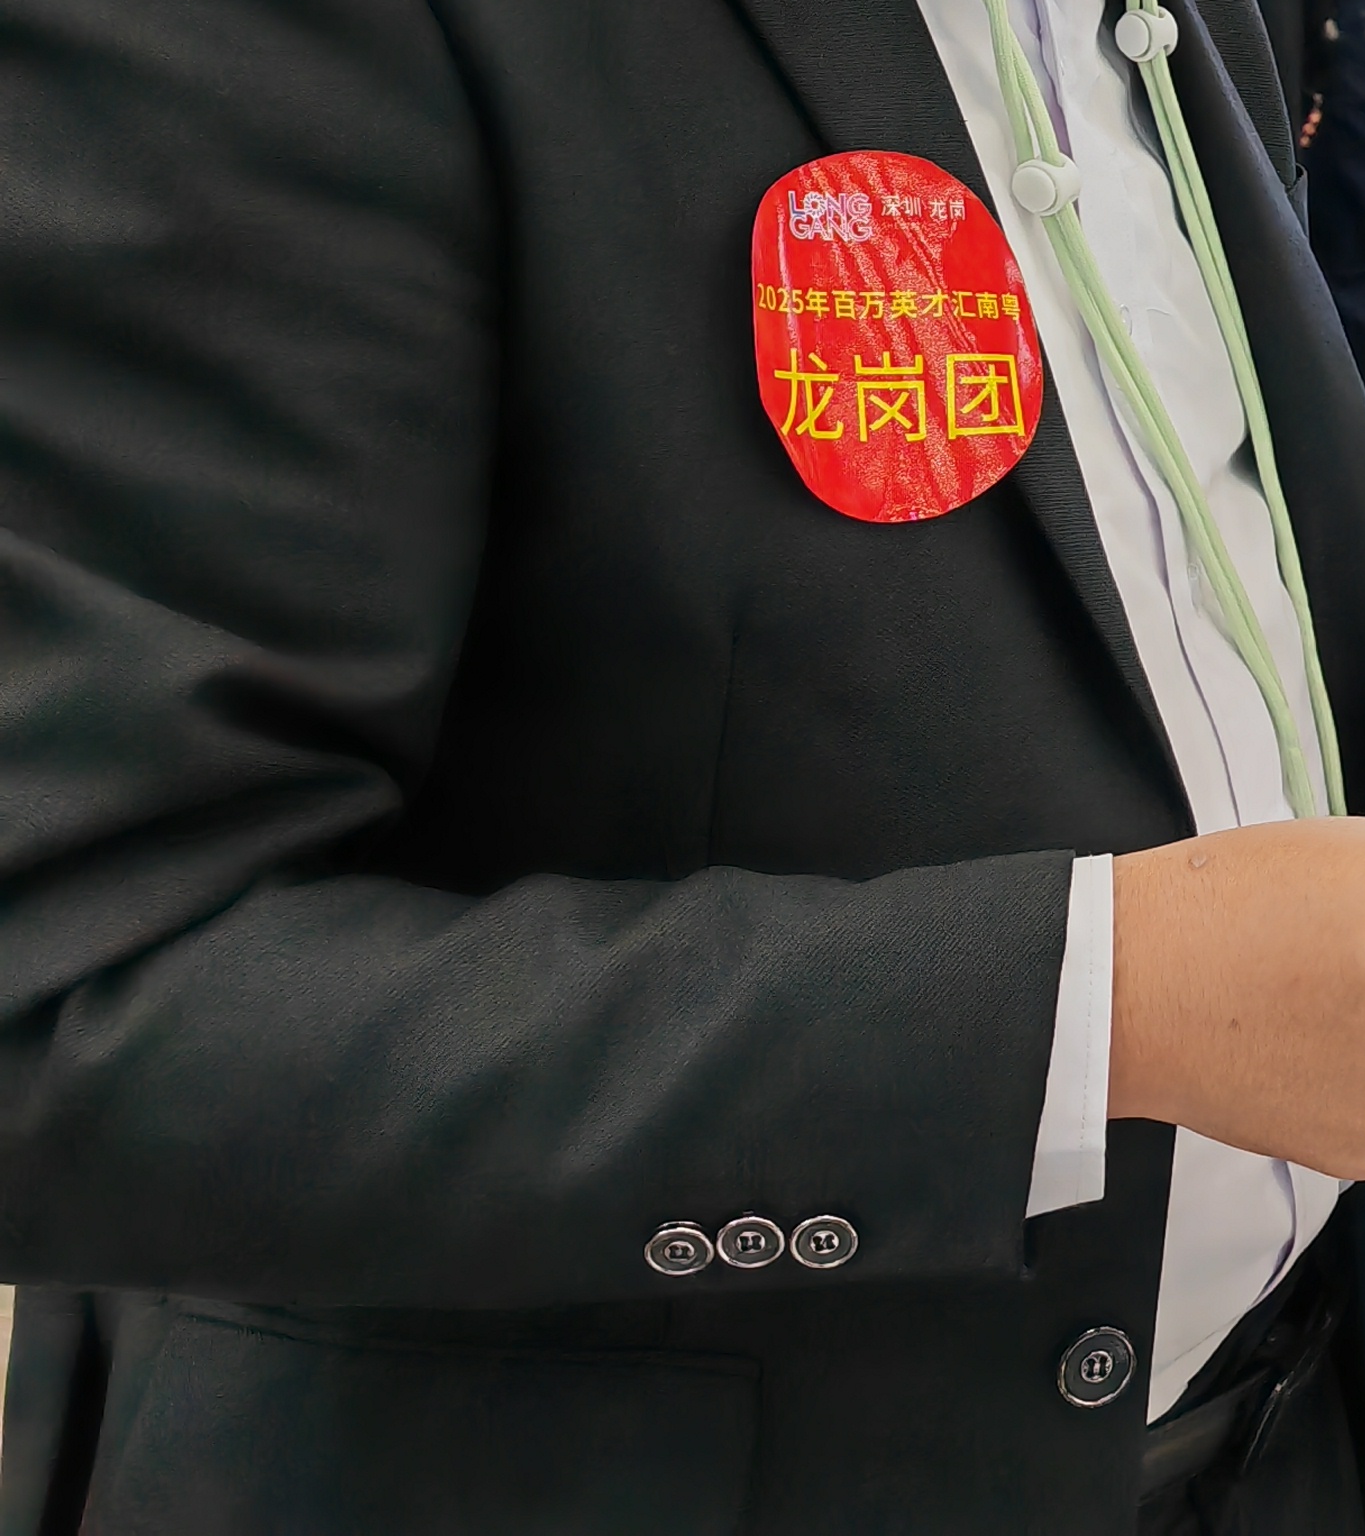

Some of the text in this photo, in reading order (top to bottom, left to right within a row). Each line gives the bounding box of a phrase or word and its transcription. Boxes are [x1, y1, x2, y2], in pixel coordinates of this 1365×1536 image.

[787, 190, 872, 216] LONG
[788, 213, 873, 241] GANG
[757, 282, 1021, 321] 2025年百万英才汇南粤
[774, 347, 1026, 442] 龙岗团
